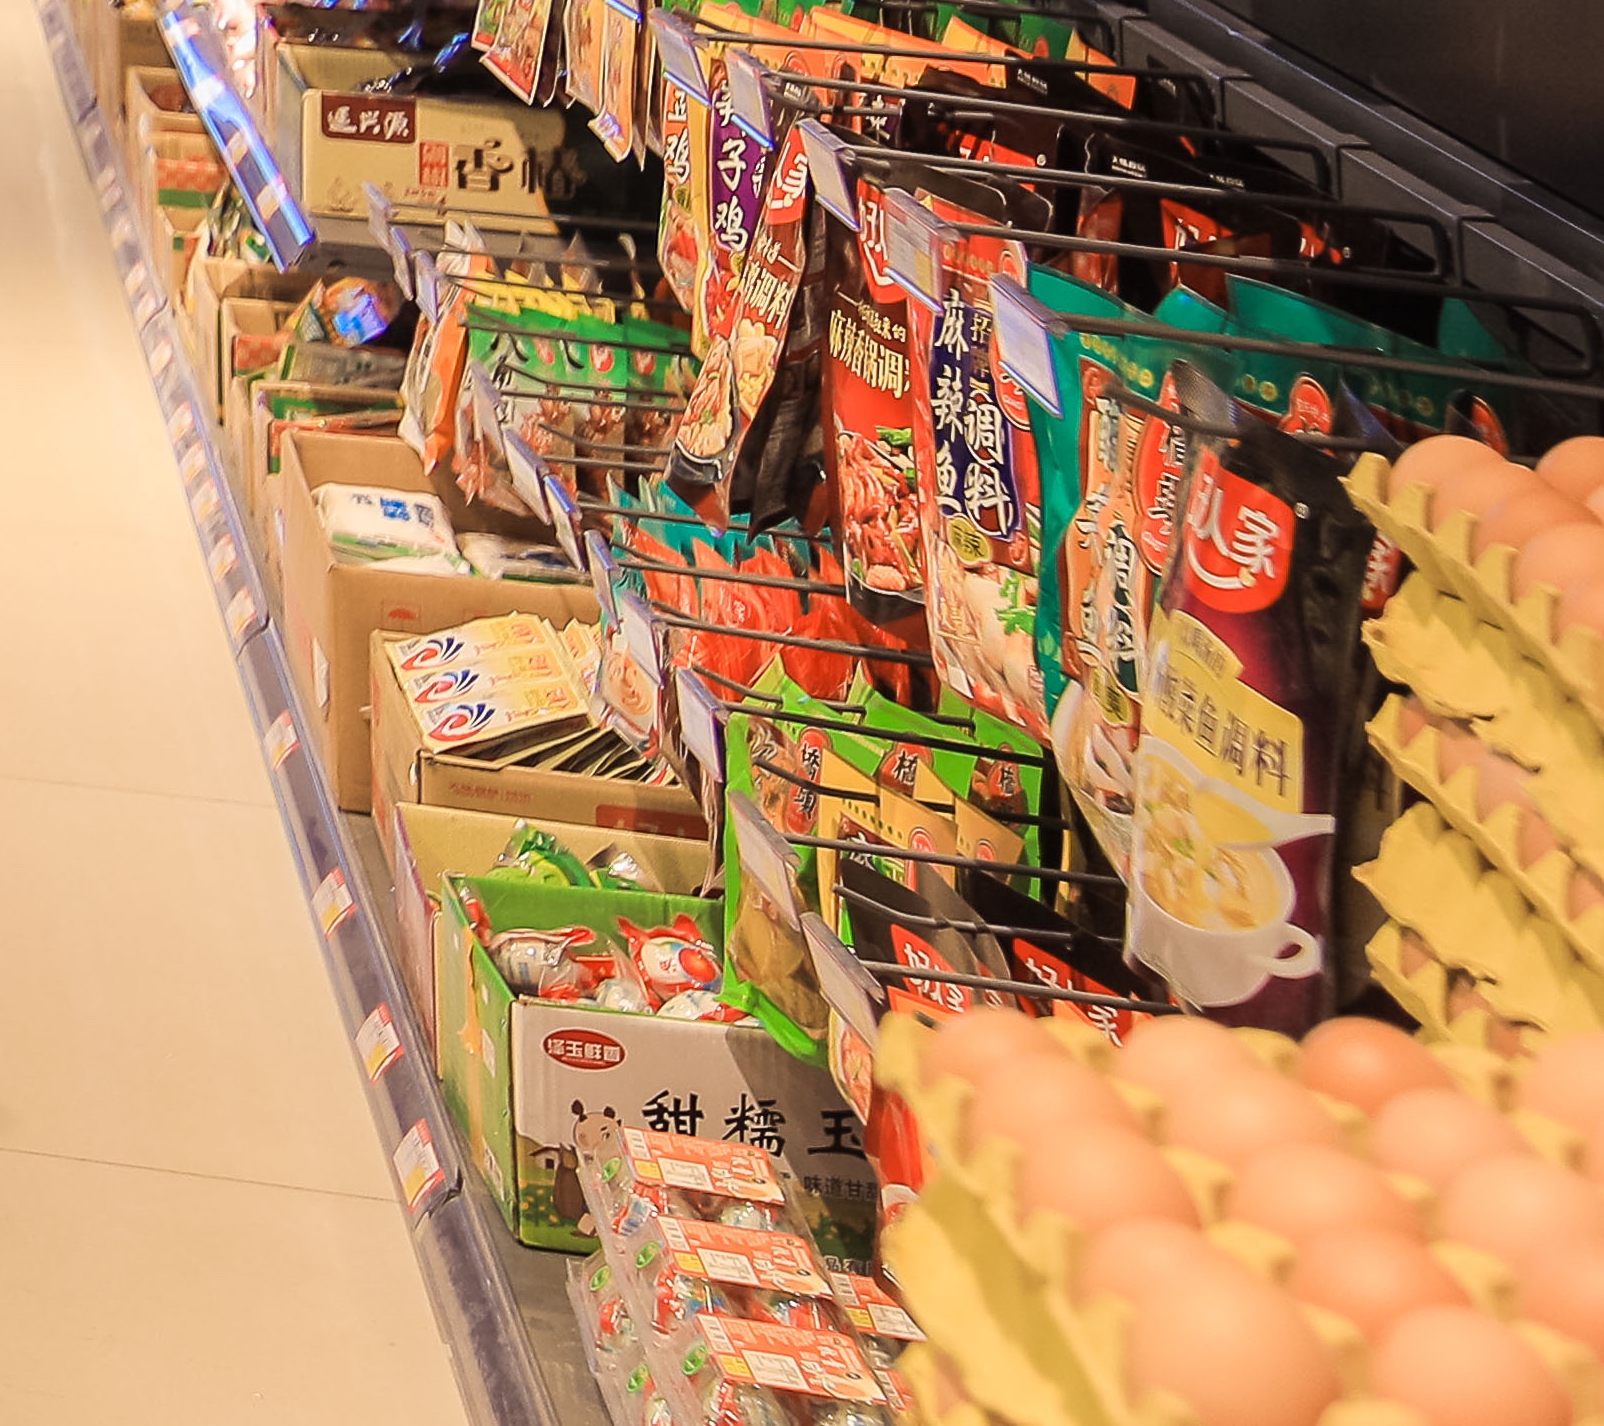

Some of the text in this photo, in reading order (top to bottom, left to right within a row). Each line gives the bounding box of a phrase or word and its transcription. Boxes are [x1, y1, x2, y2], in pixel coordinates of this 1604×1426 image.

[829, 310, 910, 399] 麻辣香锅调
